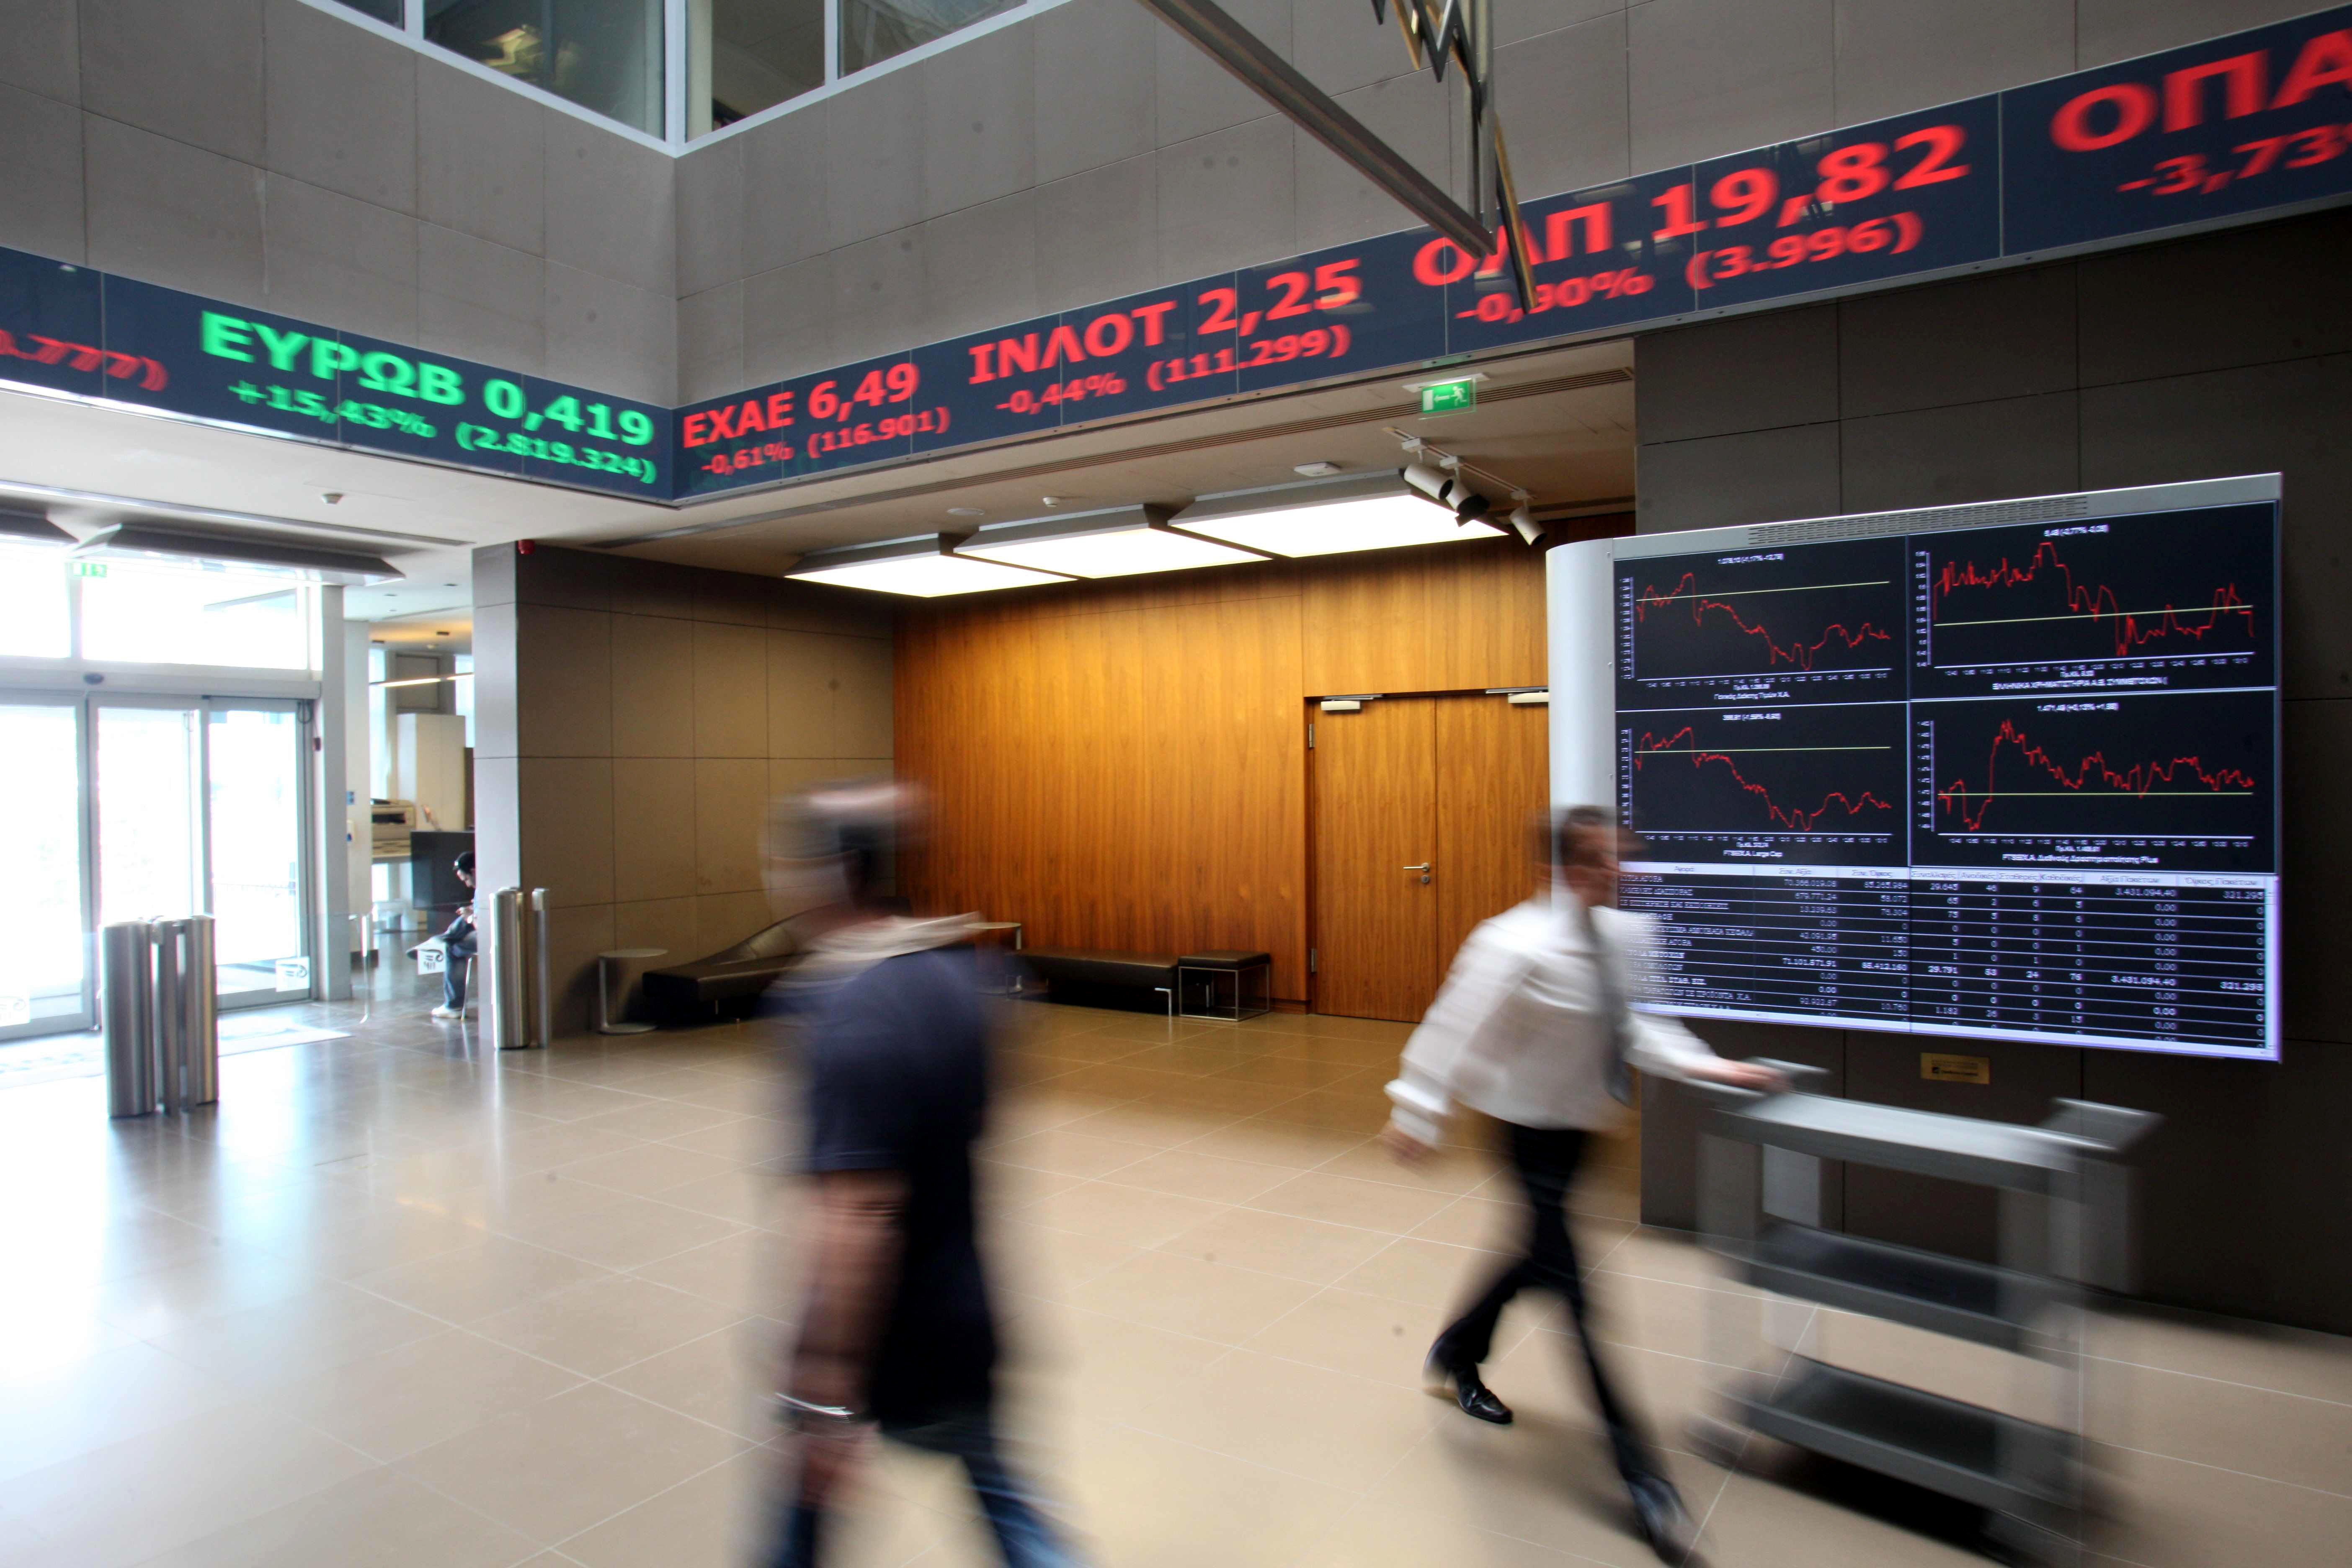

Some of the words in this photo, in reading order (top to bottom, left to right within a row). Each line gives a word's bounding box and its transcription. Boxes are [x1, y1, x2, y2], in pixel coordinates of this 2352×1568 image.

[1650, 124, 1972, 241] 19,82
[2116, 122, 2352, 195] -3,73
[1685, 211, 1924, 291] (3.996)
[969, 300, 1177, 384] ΙΝΛΟΤ
[1197, 258, 1363, 337] 2,25
[200, 310, 465, 405] ΕΥΡΩΒ
[482, 378, 654, 446] 0,419
[807, 362, 919, 422] 6,49
[995, 372, 1127, 415] -0,44%
[1146, 324, 1352, 392] (111.299)
[228, 379, 437, 438] +15,43%
[455, 421, 657, 484] (2.819.324)
[701, 441, 794, 476] -0,61%
[807, 407, 951, 458] (116.901)
